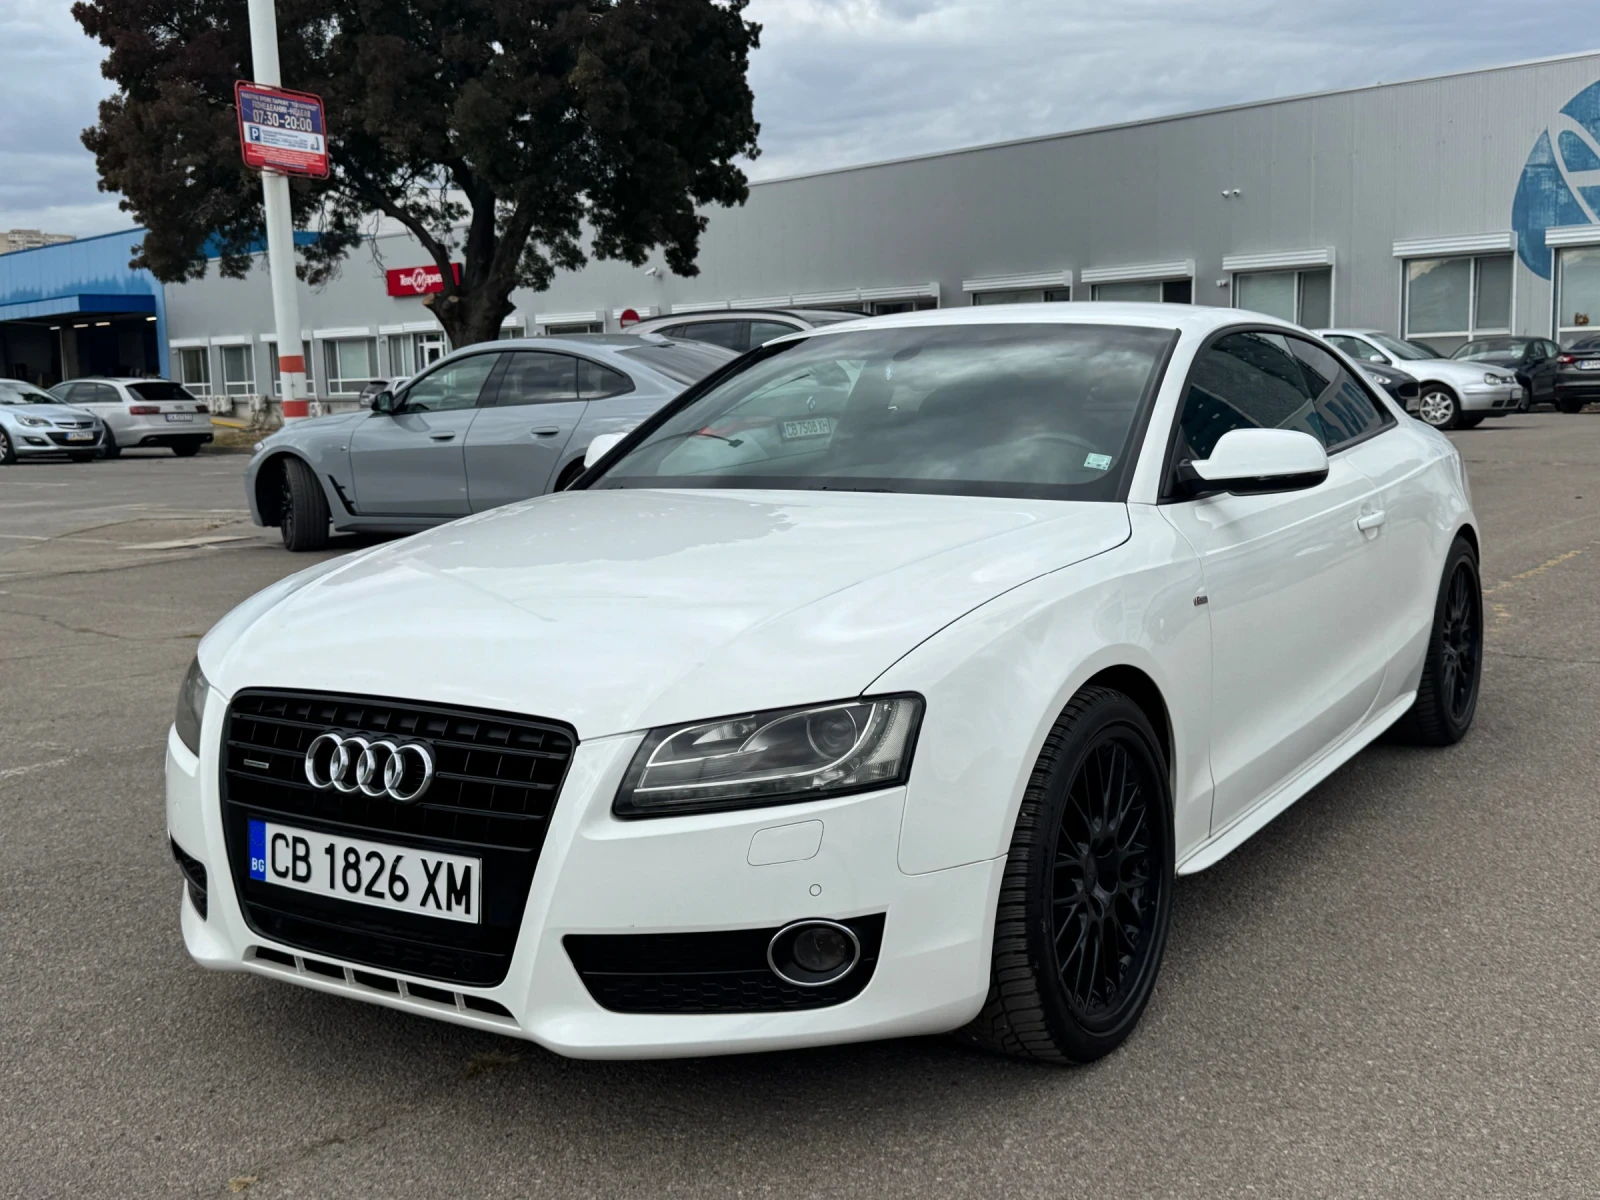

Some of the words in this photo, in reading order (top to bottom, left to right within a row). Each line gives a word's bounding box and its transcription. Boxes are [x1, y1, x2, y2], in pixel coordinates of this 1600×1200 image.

[251, 857, 265, 873] BG
[271, 832, 312, 884] CB
[324, 843, 409, 902] 1826
[419, 857, 472, 916] XM
